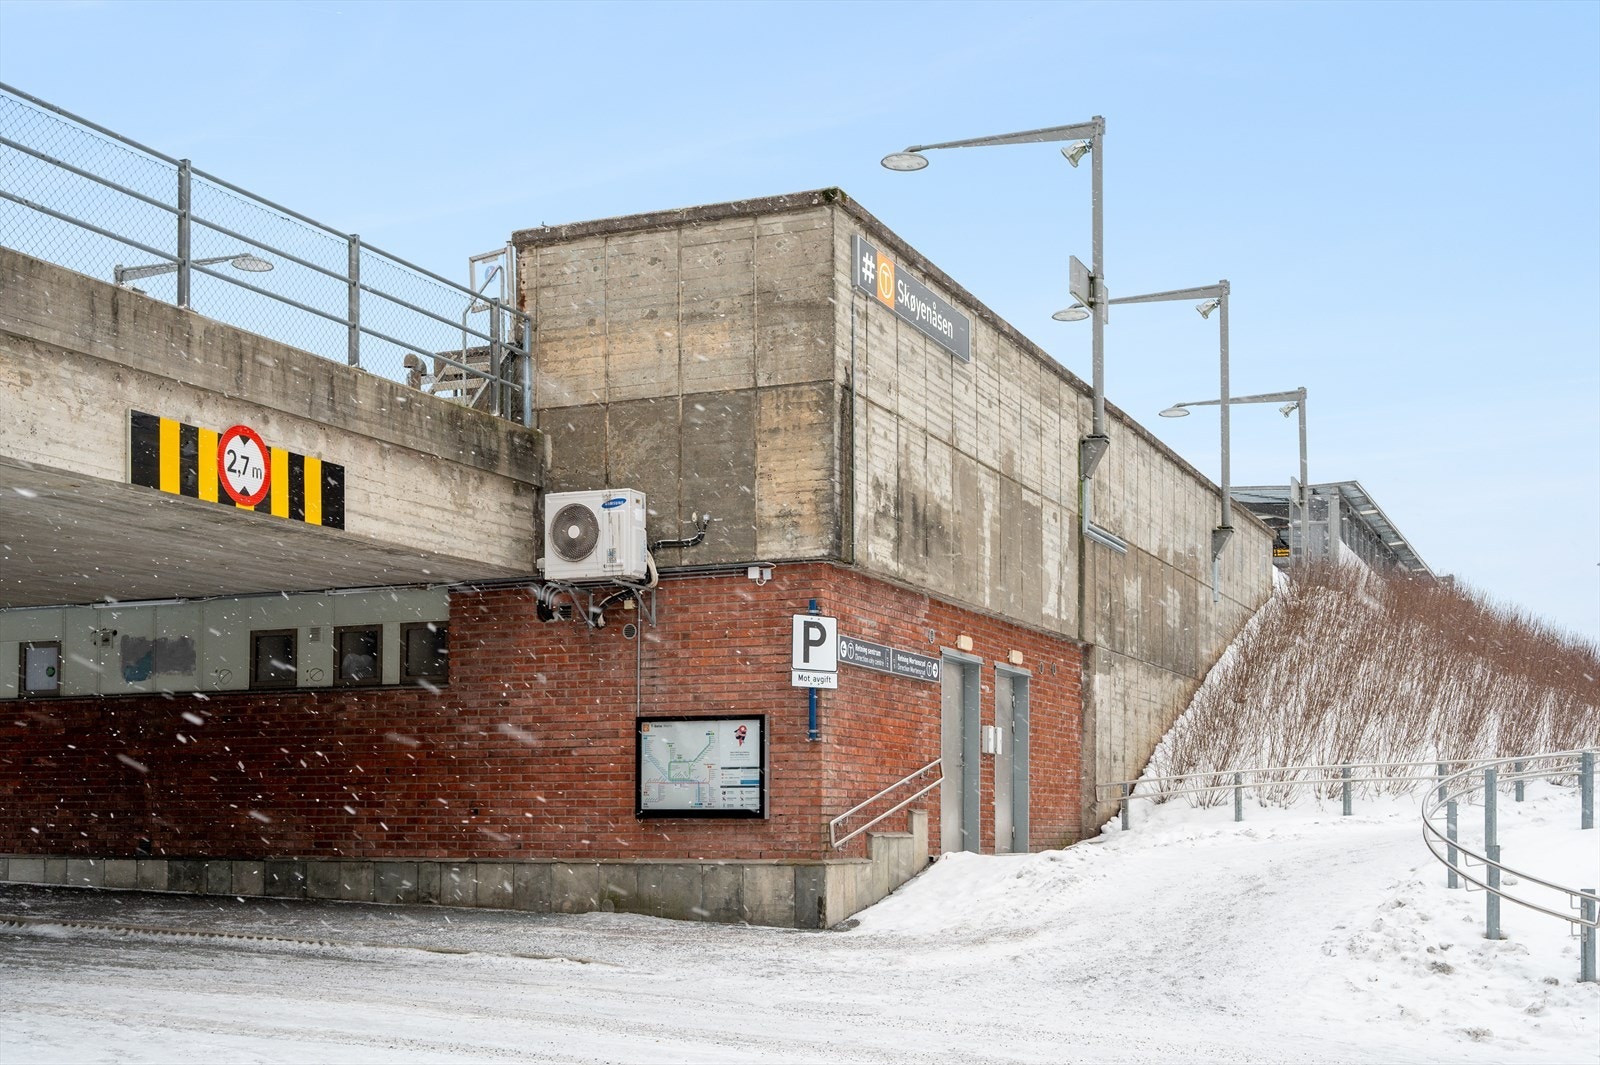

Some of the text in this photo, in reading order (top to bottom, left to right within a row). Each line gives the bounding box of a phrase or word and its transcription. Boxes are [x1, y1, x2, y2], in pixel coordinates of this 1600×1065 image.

[897, 279, 954, 339] Skøyenåsen
[227, 449, 262, 479] 2,7 m
[803, 620, 827, 663] P
[798, 674, 831, 684] Mot avgift
